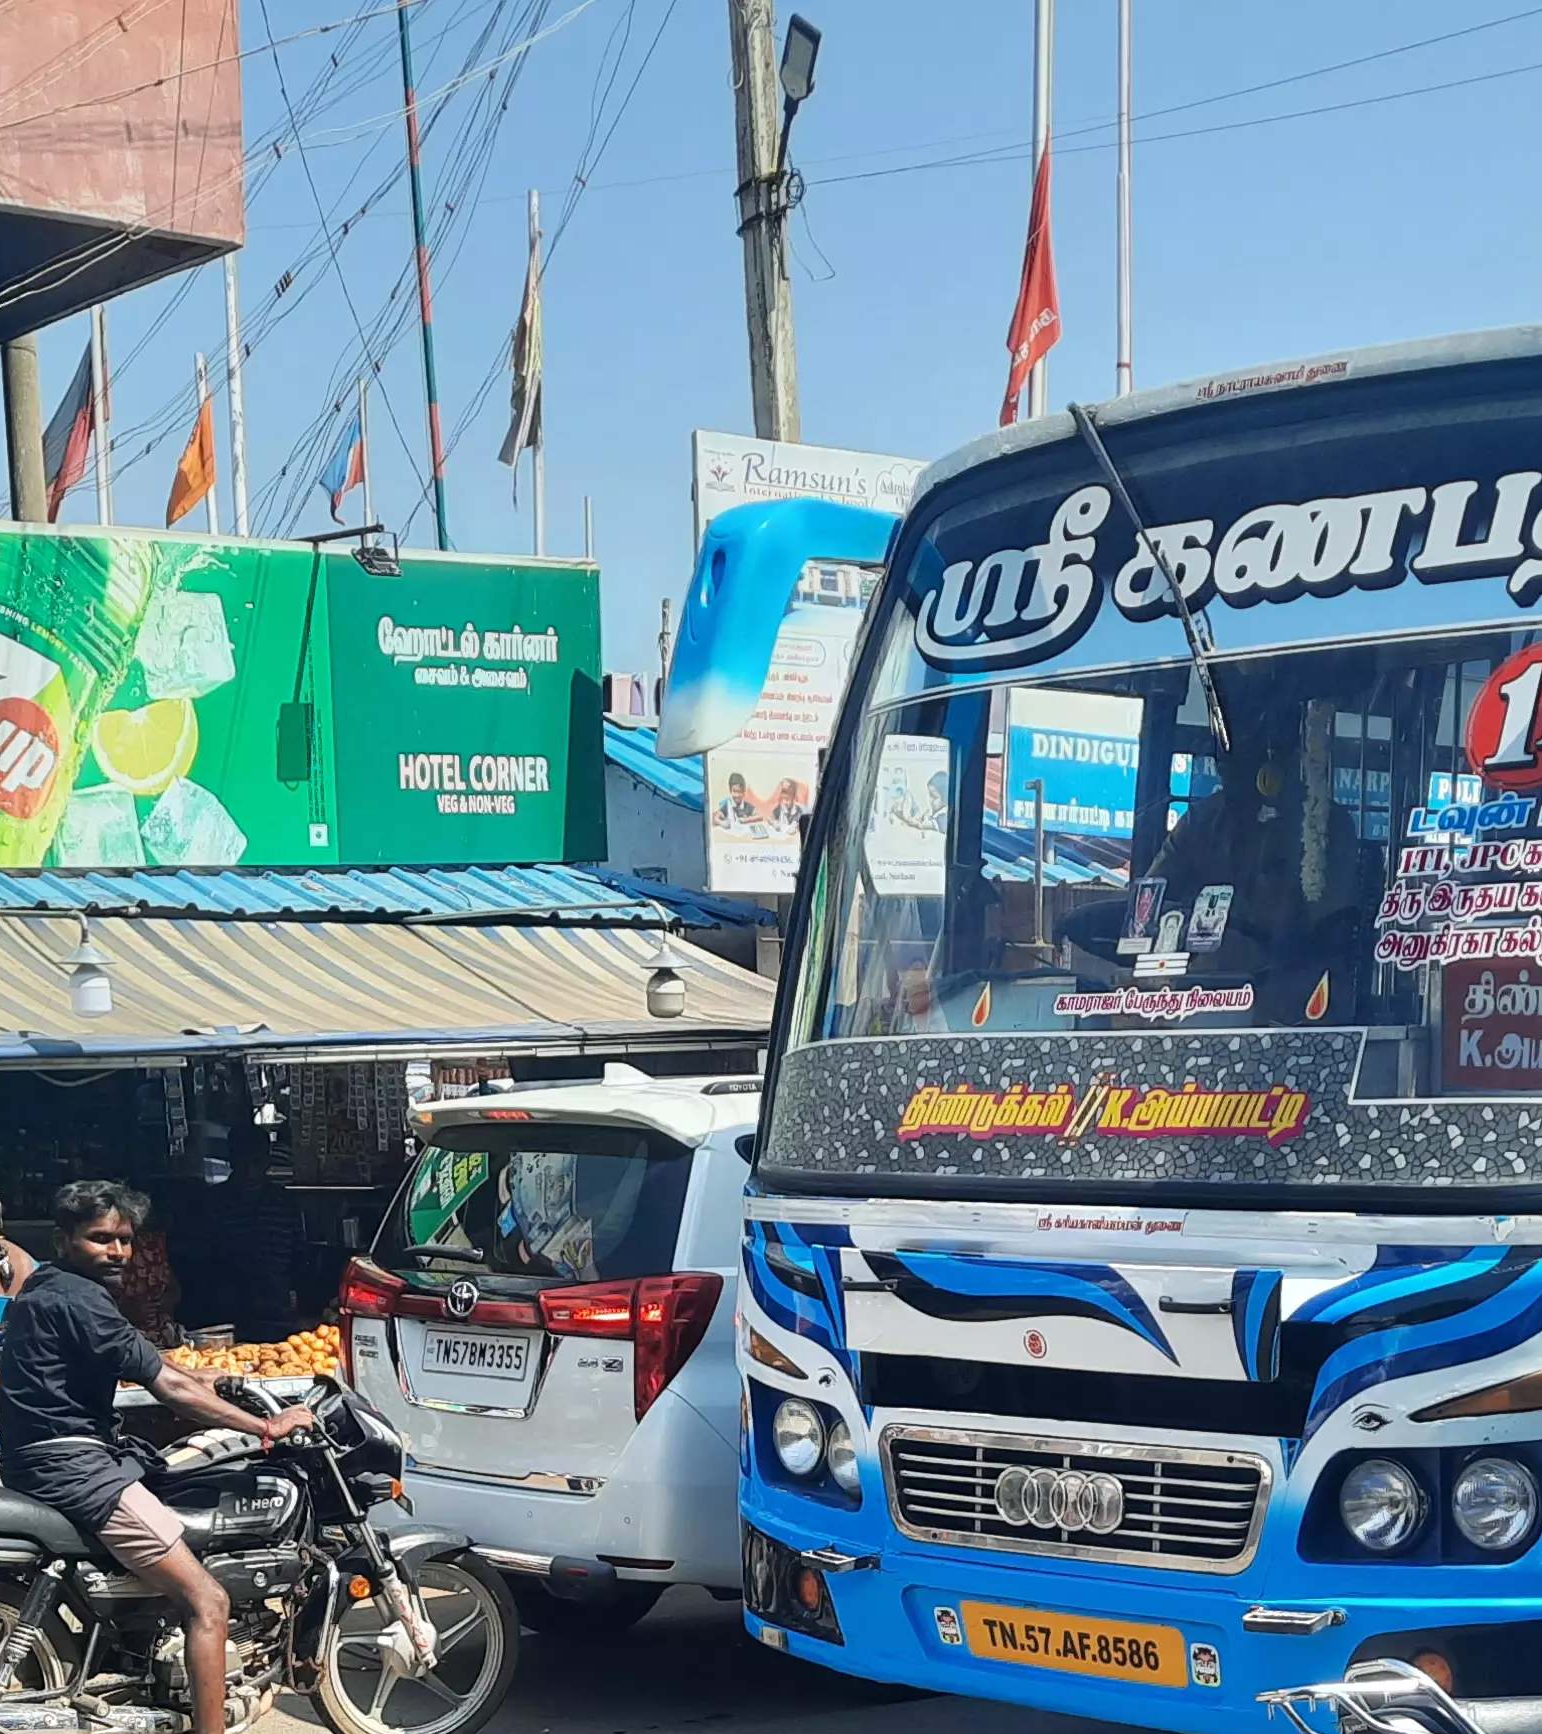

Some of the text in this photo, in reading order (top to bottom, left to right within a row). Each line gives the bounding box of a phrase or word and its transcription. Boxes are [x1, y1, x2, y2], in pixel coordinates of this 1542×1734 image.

[1305, 361, 1348, 382] துணை
[741, 452, 867, 495] Ramsun's
[915, 486, 1111, 664] ஸ்ரீ
[460, 665, 469, 685] &
[399, 753, 549, 792] HOTEL CORNER
[436, 794, 516, 814] VEG & NON-VEG
[1408, 790, 1536, 836] டவுன்
[1460, 842, 1520, 873] JPC
[1375, 884, 1425, 928] திரு
[1426, 880, 1518, 923] இருதய
[1375, 922, 1498, 971] அனுகிரகா
[1053, 988, 1123, 1018] காமராஜர்
[1183, 982, 1255, 1015] நிலையம்
[897, 1083, 1074, 1144] திண்டுக்கல்
[435, 1338, 525, 1371] TN57BM3355
[251, 1496, 284, 1511] Hero
[982, 1618, 1160, 1671] TN.57.AF.8586
